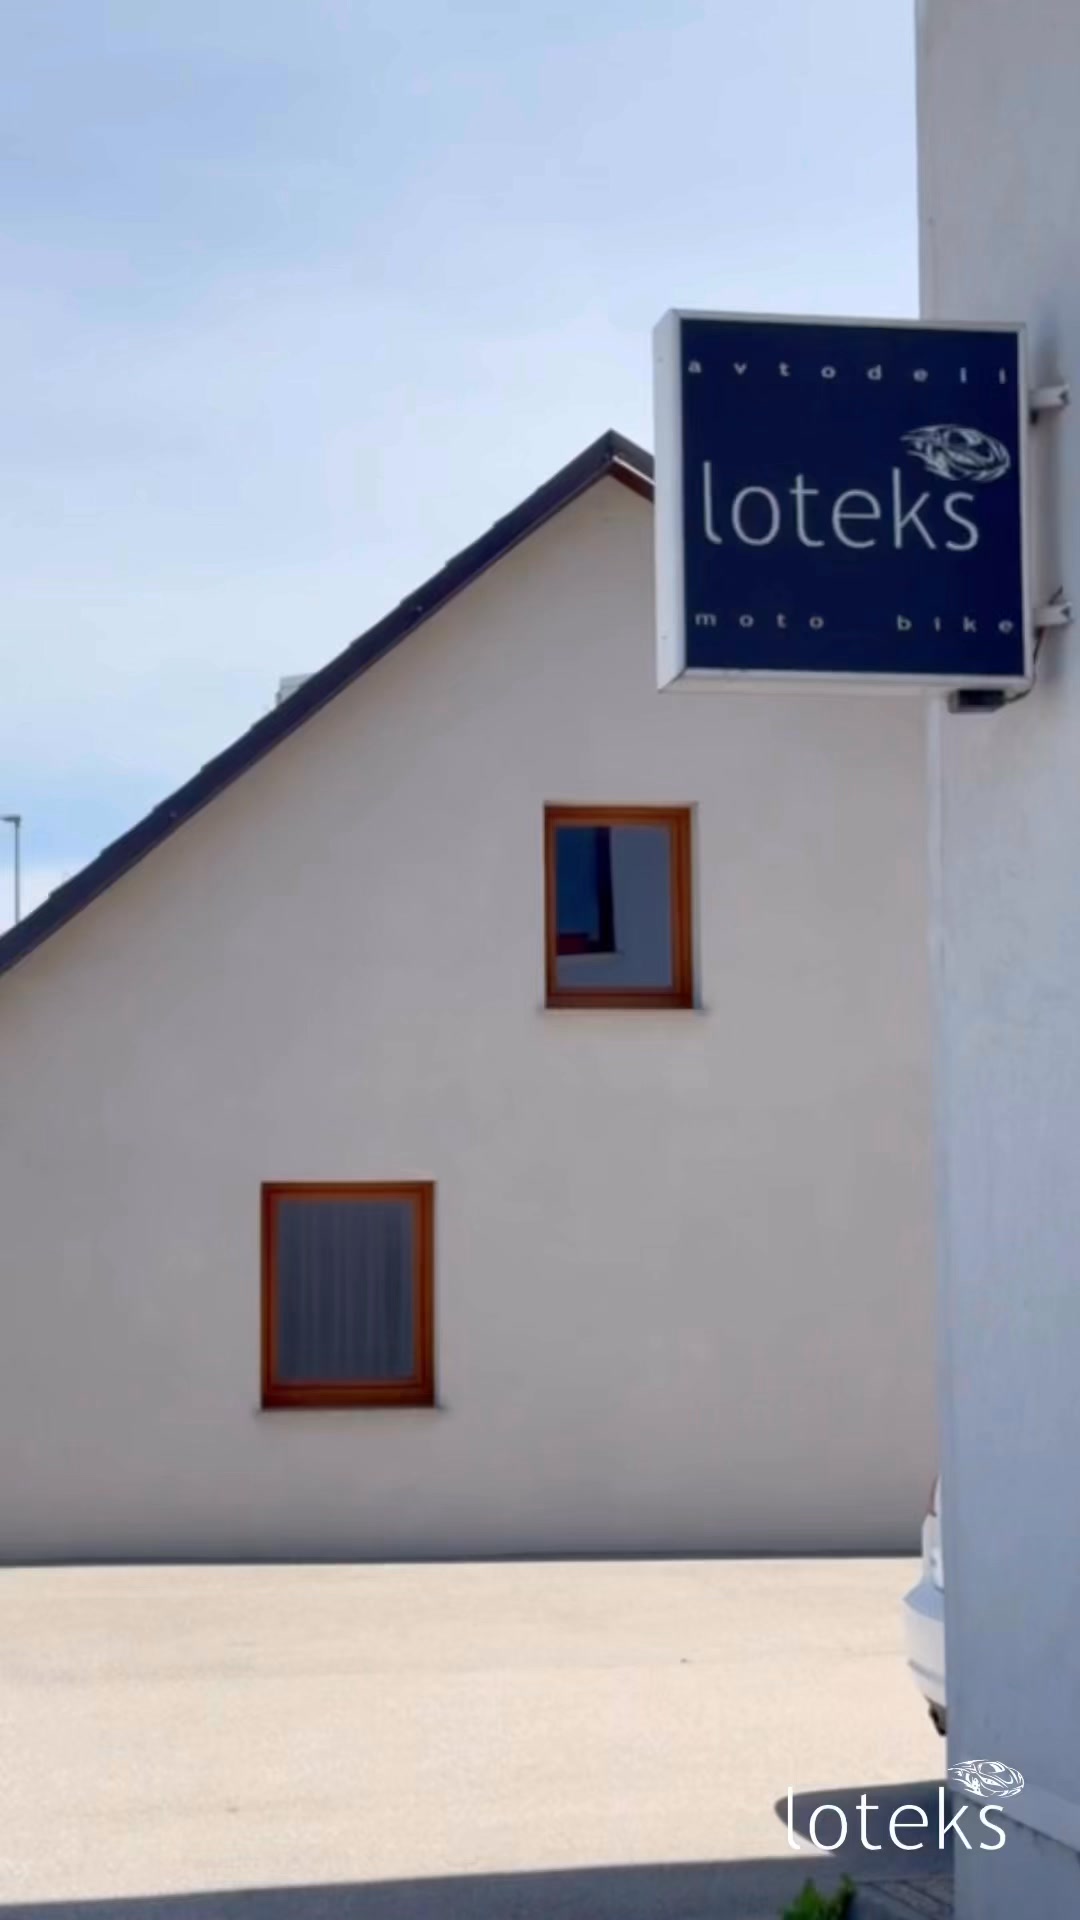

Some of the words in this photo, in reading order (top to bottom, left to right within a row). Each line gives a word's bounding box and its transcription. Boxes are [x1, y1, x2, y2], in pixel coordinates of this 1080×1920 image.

[703, 461, 979, 551] loteks
[695, 613, 824, 629] moto
[896, 614, 1014, 634] bike
